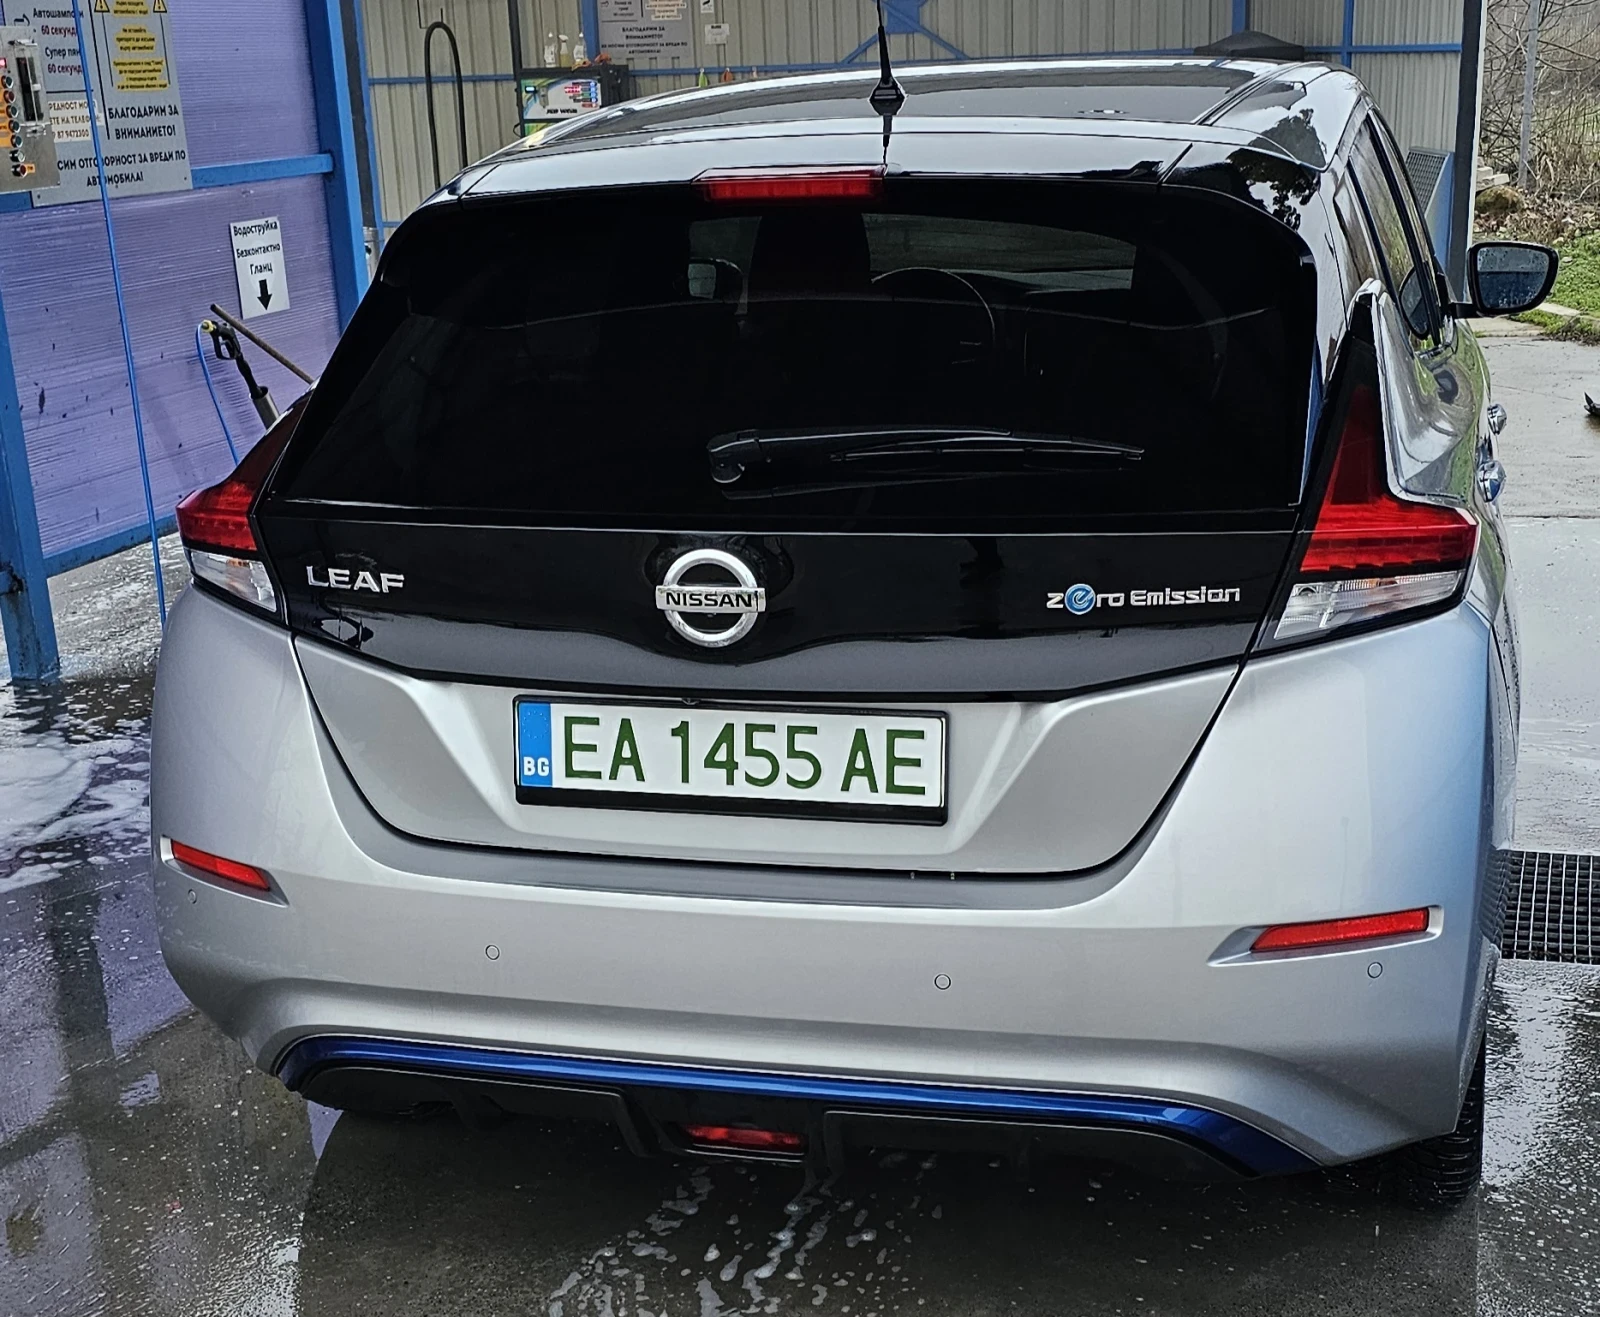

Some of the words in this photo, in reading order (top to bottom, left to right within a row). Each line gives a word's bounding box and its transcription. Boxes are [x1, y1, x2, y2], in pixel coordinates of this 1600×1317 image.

[33, 8, 84, 19] Автошампон
[41, 25, 50, 36] 60
[45, 46, 67, 60] Супер
[47, 63, 57, 74] 60
[108, 105, 167, 120] БЛАГОДАРИМ
[168, 104, 179, 116] ЗА
[115, 124, 176, 140] ВНИМАНИЕТО!
[79, 153, 137, 170] ОТГООРНОСТ
[138, 153, 149, 164] ЗА
[149, 151, 173, 162] ВРЕДИ
[175, 150, 186, 161] ПО
[87, 172, 144, 187] АВТМОБИЛА!
[233, 219, 278, 237] Водоструйка
[236, 243, 281, 258] Безконтактно
[250, 262, 273, 275] Гланц
[305, 565, 405, 594] LEAF
[666, 591, 753, 608] NISSAN
[1046, 583, 1125, 615] zero
[1130, 586, 1240, 607] Emission
[564, 715, 645, 783] EA
[670, 720, 822, 790] 1455
[840, 727, 926, 796] AE
[522, 756, 550, 777] BG
